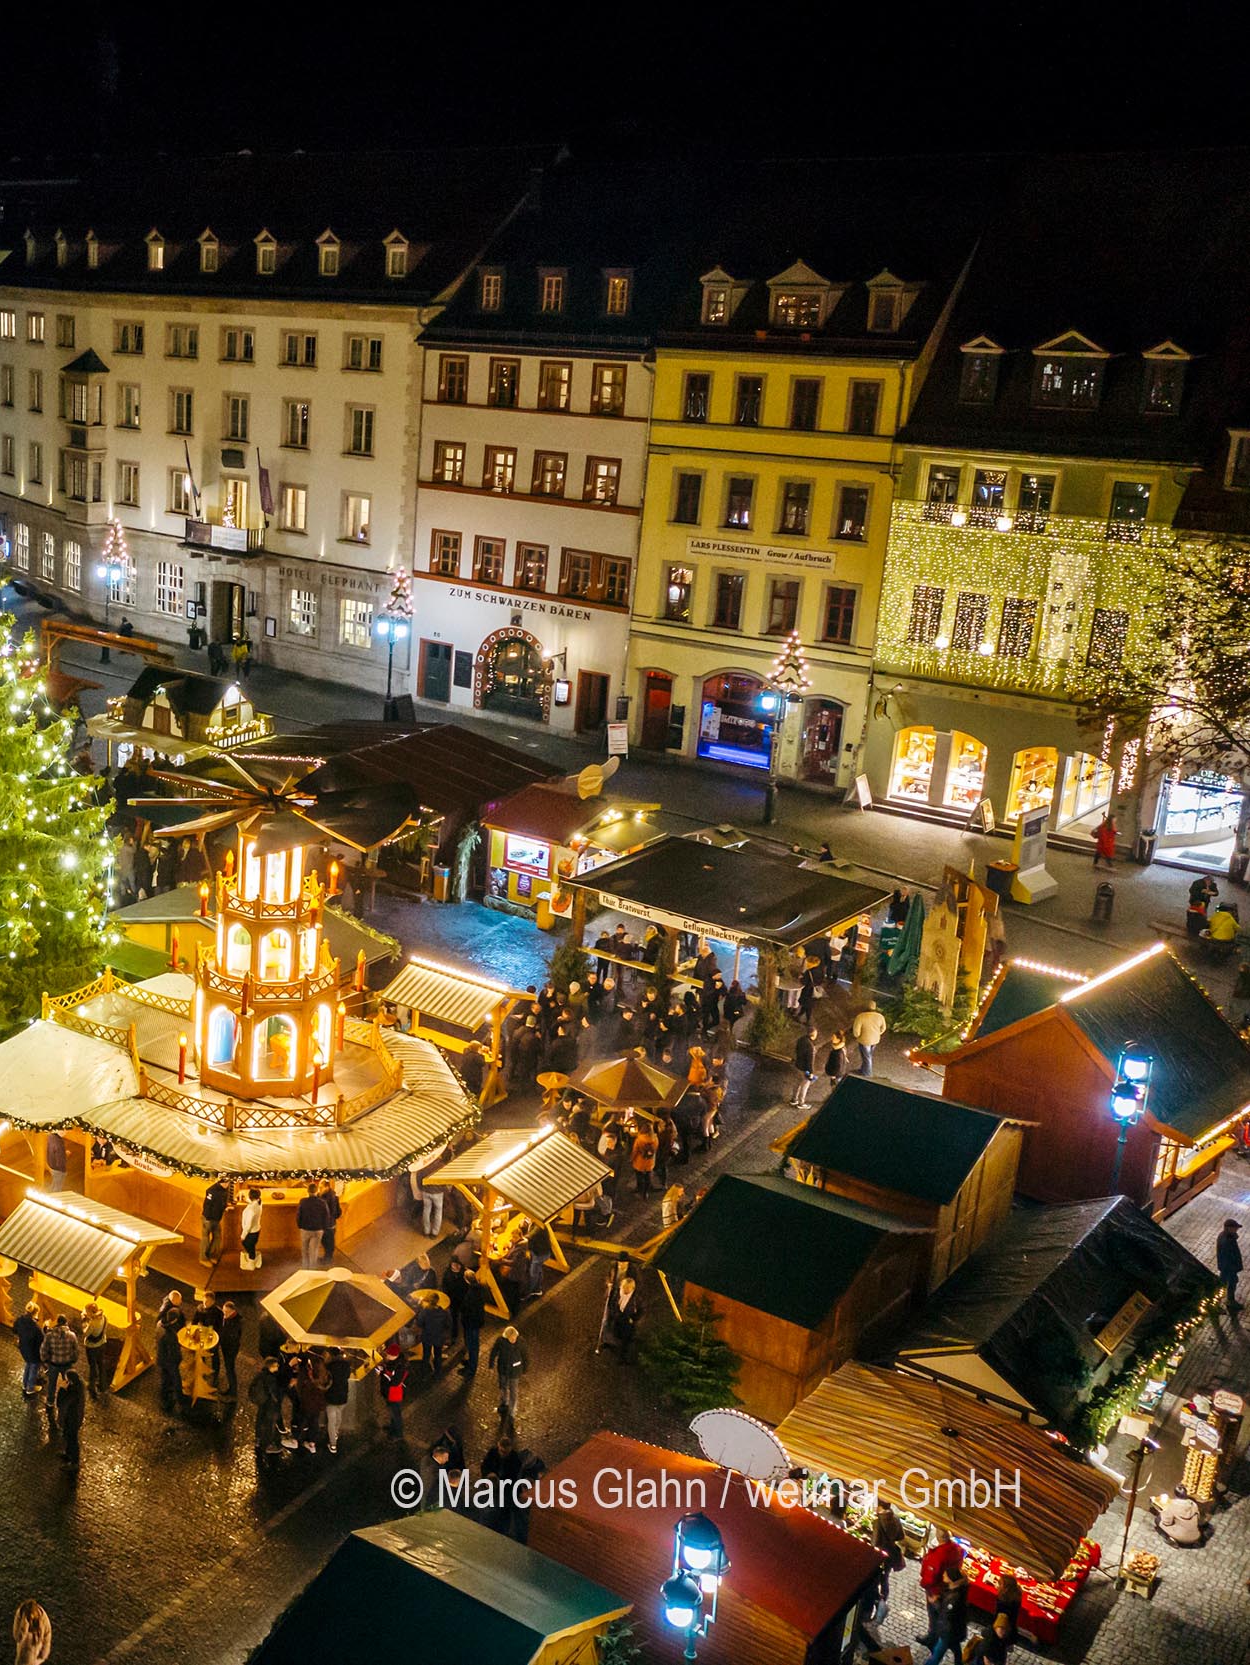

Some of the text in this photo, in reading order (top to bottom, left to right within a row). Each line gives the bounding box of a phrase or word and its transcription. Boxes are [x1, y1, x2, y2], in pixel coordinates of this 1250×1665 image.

[691, 541, 711, 549] LARS
[712, 543, 760, 555] PLESSENTIN
[794, 552, 832, 563] Aufbruch
[279, 567, 381, 593] HOTEL ELEPHANT
[450, 587, 591, 621] ZUM SCHWARZEN BÄREN
[618, 899, 651, 918] Bratwurst
